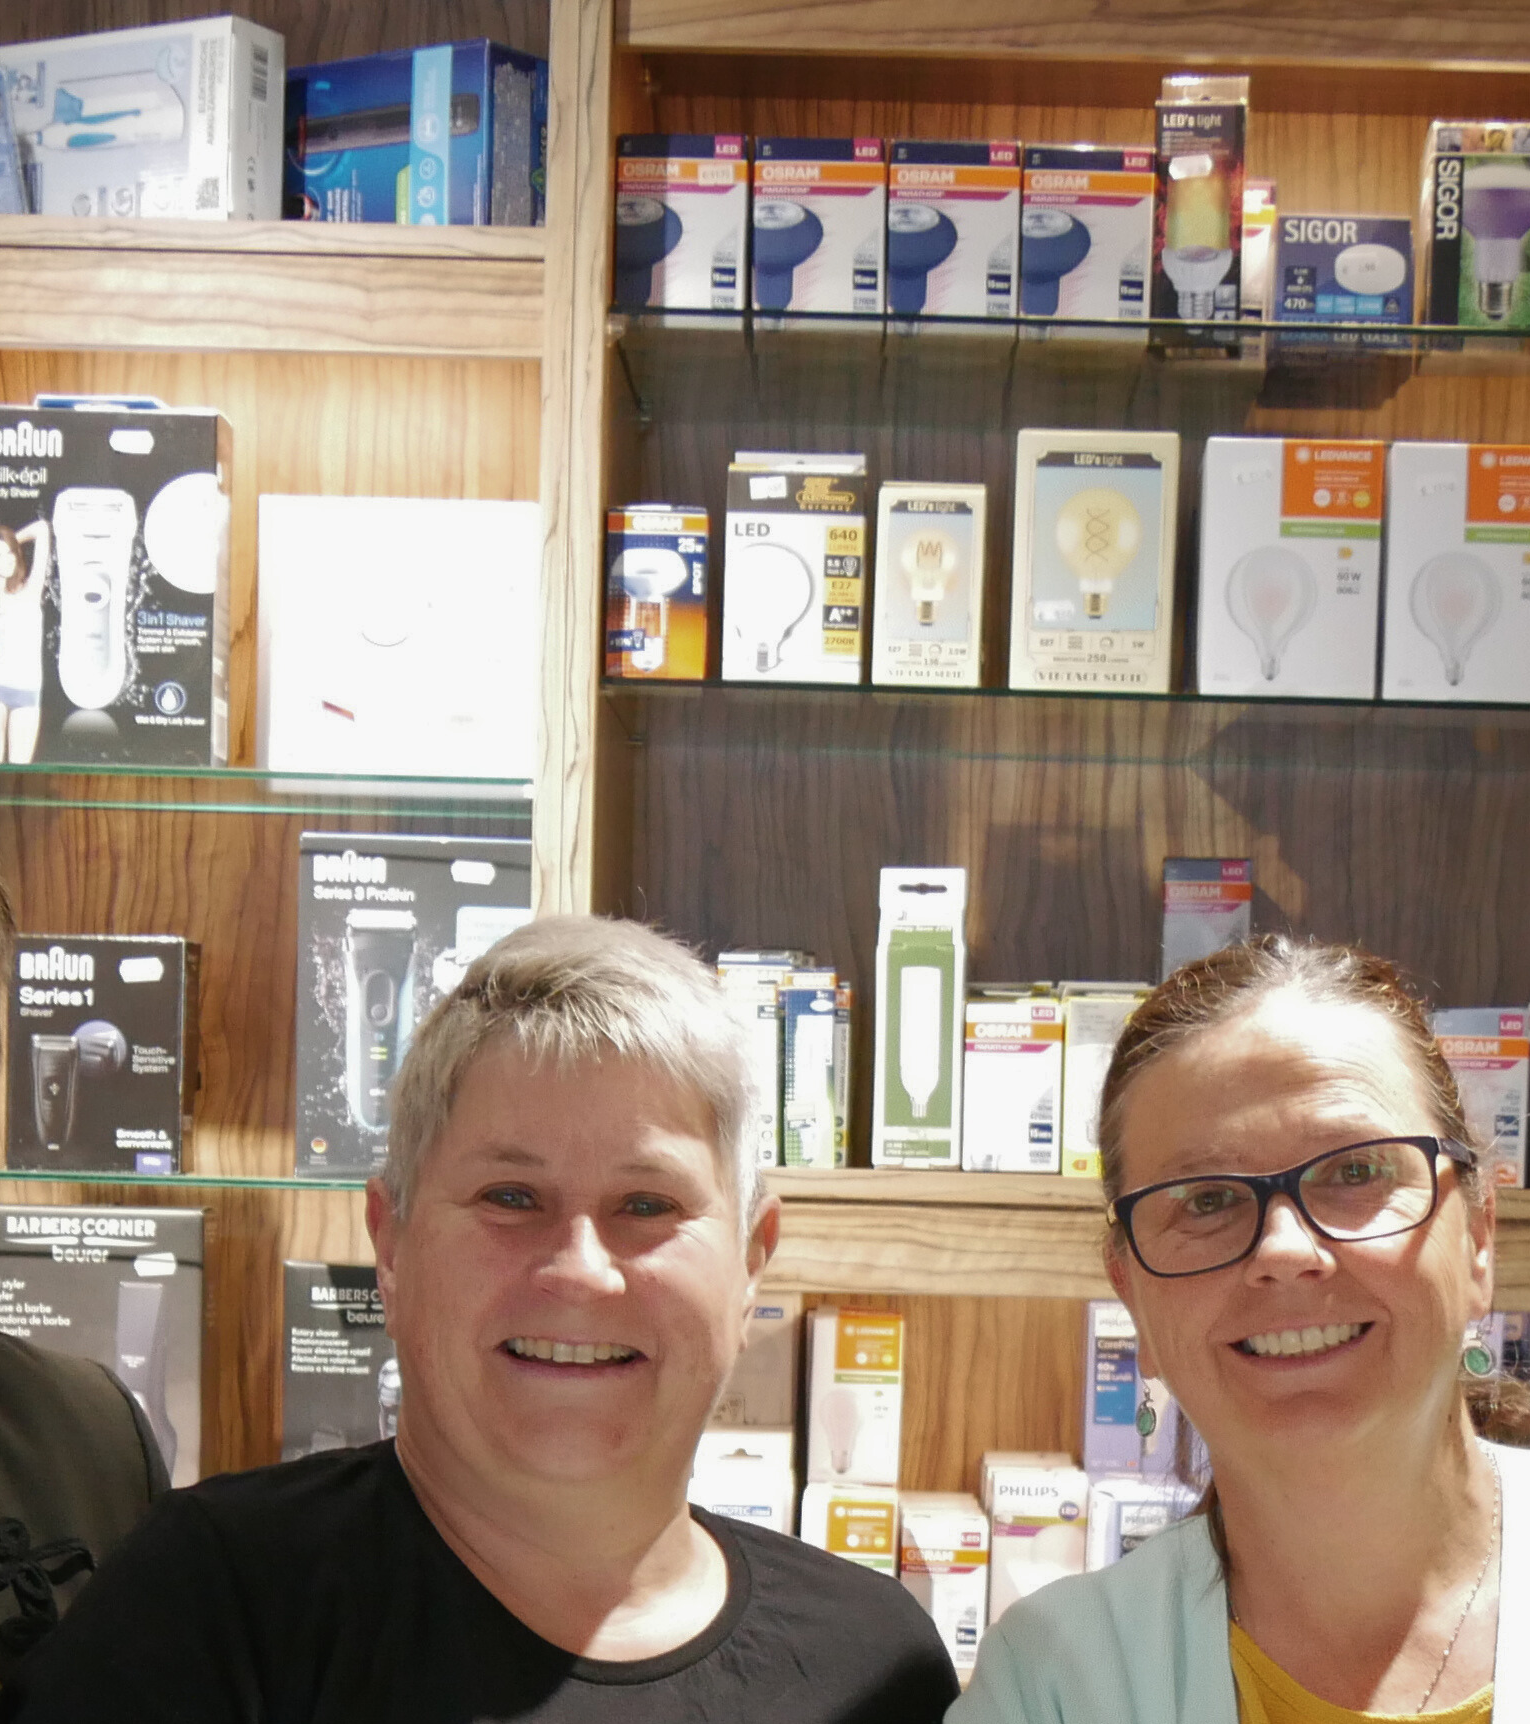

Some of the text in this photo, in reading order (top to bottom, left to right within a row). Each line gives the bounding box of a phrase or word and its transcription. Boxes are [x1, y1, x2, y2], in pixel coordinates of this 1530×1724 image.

[1197, 114, 1222, 129] light
[715, 144, 739, 155] LED
[855, 147, 878, 157] LED
[990, 150, 1014, 162] LED
[1125, 156, 1148, 168] LED
[623, 163, 679, 177] OSRAM
[762, 165, 819, 180] OSRAM
[897, 170, 955, 185] OSRAM
[1030, 175, 1089, 190] OSRAM
[1435, 158, 1459, 241] SIGOR
[1284, 220, 1357, 244] SIGOR
[1314, 450, 1372, 463] LEDVANCE
[735, 523, 770, 537] LED
[830, 530, 858, 541] 640
[313, 850, 387, 883] BRAUN
[313, 885, 415, 902] Series ProSkin
[20, 946, 95, 981] BRAUN
[20, 986, 94, 1006] Series 1
[20, 1008, 54, 1018] Shaver
[1032, 1008, 1054, 1019] LED
[975, 1023, 1032, 1039] OSRAM
[1500, 1021, 1522, 1030] LED
[1443, 1040, 1500, 1054] OSRAM
[133, 1055, 175, 1065] Sensitive
[133, 1064, 169, 1075] System
[116, 1128, 156, 1139] Smooth
[7, 1216, 157, 1237] BARBERS CORNER
[52, 1245, 109, 1263] beurer
[2, 1279, 26, 1291] styler
[311, 1287, 369, 1301] BARBERS
[29, 1315, 70, 1327] de barba
[1098, 1340, 1135, 1349] CorePro
[999, 1484, 1059, 1498] PHILIPS
[961, 1533, 981, 1545] LED
[906, 1549, 954, 1562] OSRAM
